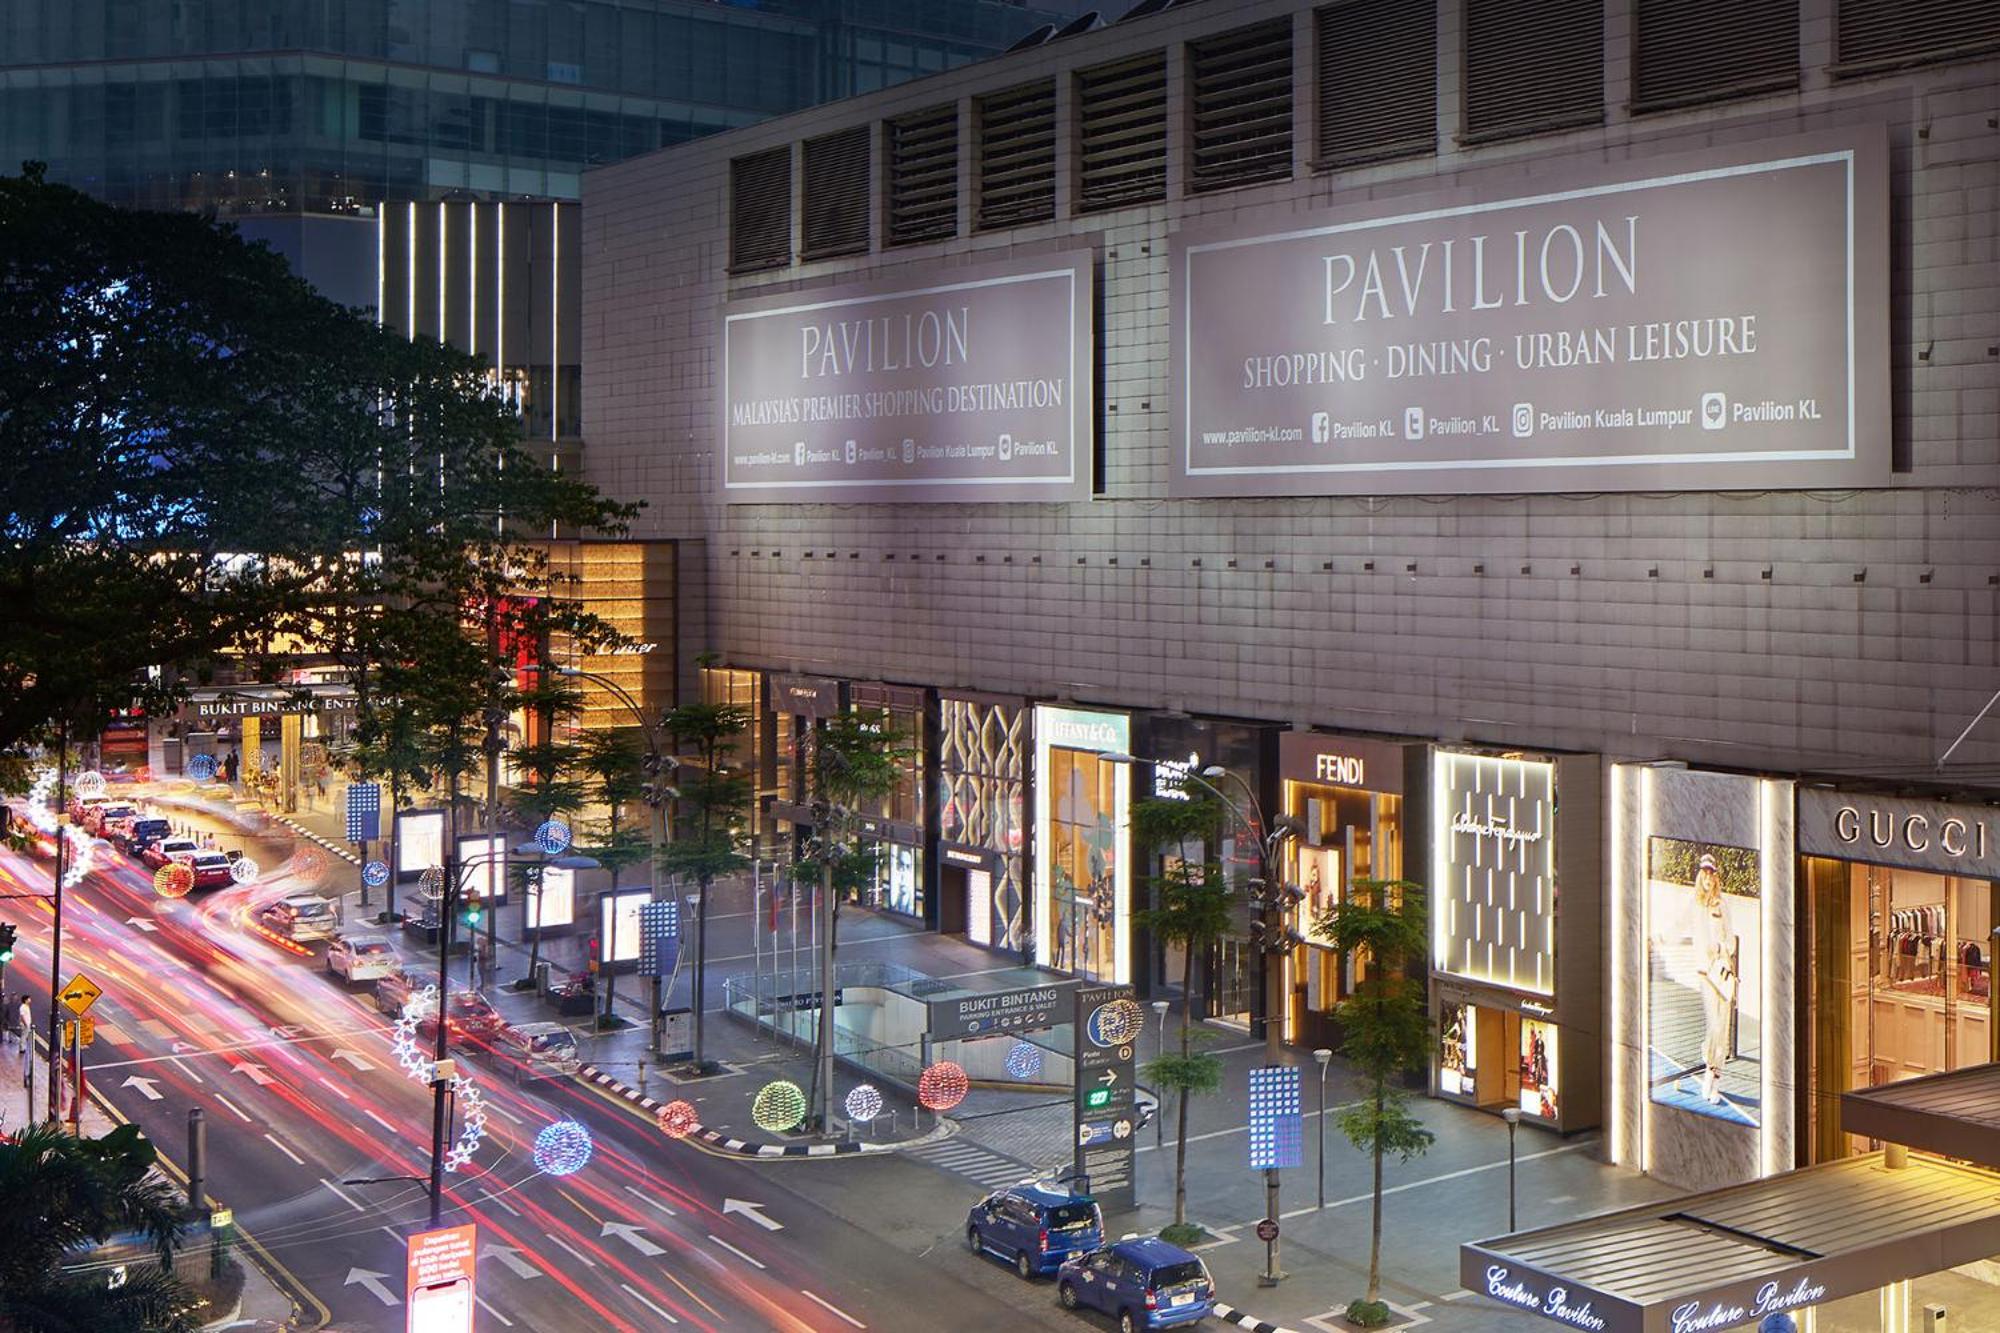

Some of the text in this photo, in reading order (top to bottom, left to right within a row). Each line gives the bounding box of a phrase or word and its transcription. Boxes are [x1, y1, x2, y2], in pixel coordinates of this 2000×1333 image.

[1322, 215, 1640, 325] PAVILION
[801, 307, 969, 379] PAVILION
[1244, 315, 1757, 389] SHOPPING DINING URBAN LEISURE
[732, 378, 1063, 426] MALAYSIA'S PREMIER SHOPPING DESTINATION
[1733, 399, 1822, 422] Pavilion KL
[1333, 420, 1395, 439] Pavilion KL
[1540, 406, 1693, 430] Pavilion Kuala Lumpur
[1014, 441, 1045, 456] Pavilion
[1202, 426, 1302, 447] www.pavilion-kl.com
[200, 702, 247, 715] BUKIT
[1316, 753, 1364, 785] FENDI
[1834, 806, 1985, 860] GUCCI
[960, 989, 1057, 1013] BUKIT BINTANG
[991, 1005, 1028, 1017] ENTRANCE
[1122, 1048, 1130, 1058] D
[1486, 1265, 1606, 1332] Couture Pavilion
[1671, 1277, 1826, 1333] Couture Pavilion
